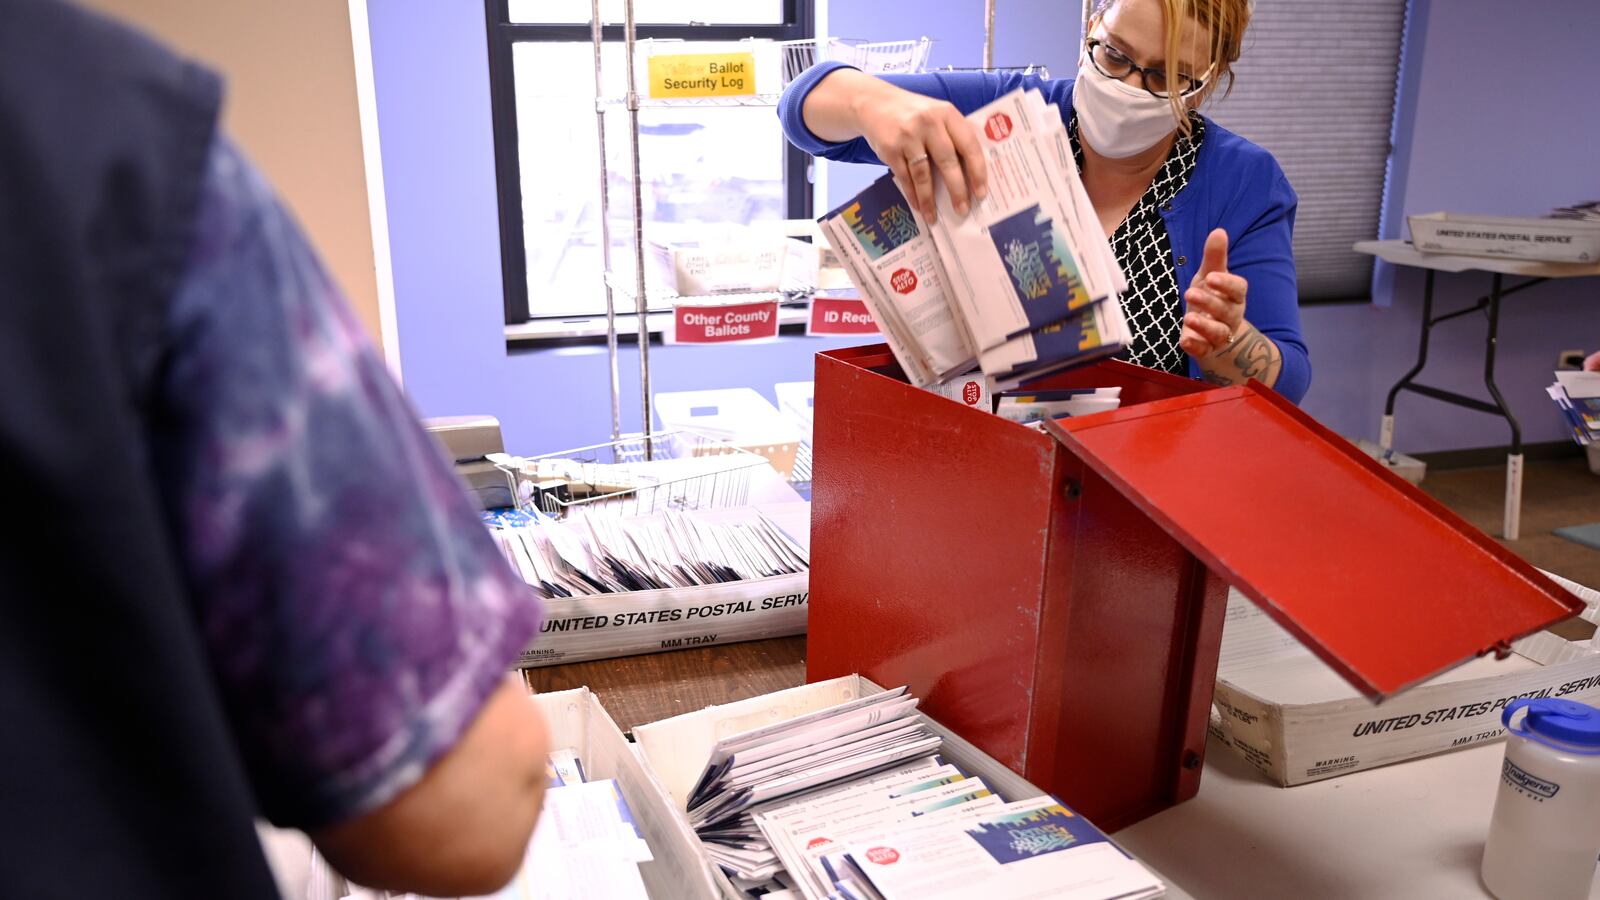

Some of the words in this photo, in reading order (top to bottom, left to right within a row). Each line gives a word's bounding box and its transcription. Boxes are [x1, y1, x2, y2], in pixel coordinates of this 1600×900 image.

[709, 62, 744, 73] Ballot
[664, 77, 718, 91] Security
[721, 76, 744, 89] Log
[1436, 229, 1465, 238] UNITED
[1534, 234, 1573, 243] SERVICE
[892, 269, 911, 286] STOP
[896, 277, 914, 293] ALTO
[683, 313, 722, 326] Other
[724, 310, 771, 323] County
[824, 310, 840, 323] ID
[704, 324, 751, 337] Ballots
[540, 615, 609, 633] UNITED
[612, 608, 682, 627] STATES
[686, 600, 755, 619] POSTAL
[761, 592, 809, 610] SERV
[661, 639, 682, 648] MM
[684, 634, 717, 645] TRAY
[520, 648, 555, 656] WARNING
[1353, 714, 1421, 737] UNITED
[1421, 701, 1492, 726] STATES
[1452, 736, 1473, 747] MM
[1476, 728, 1505, 741] TRAY
[1315, 755, 1356, 767] WARNING
